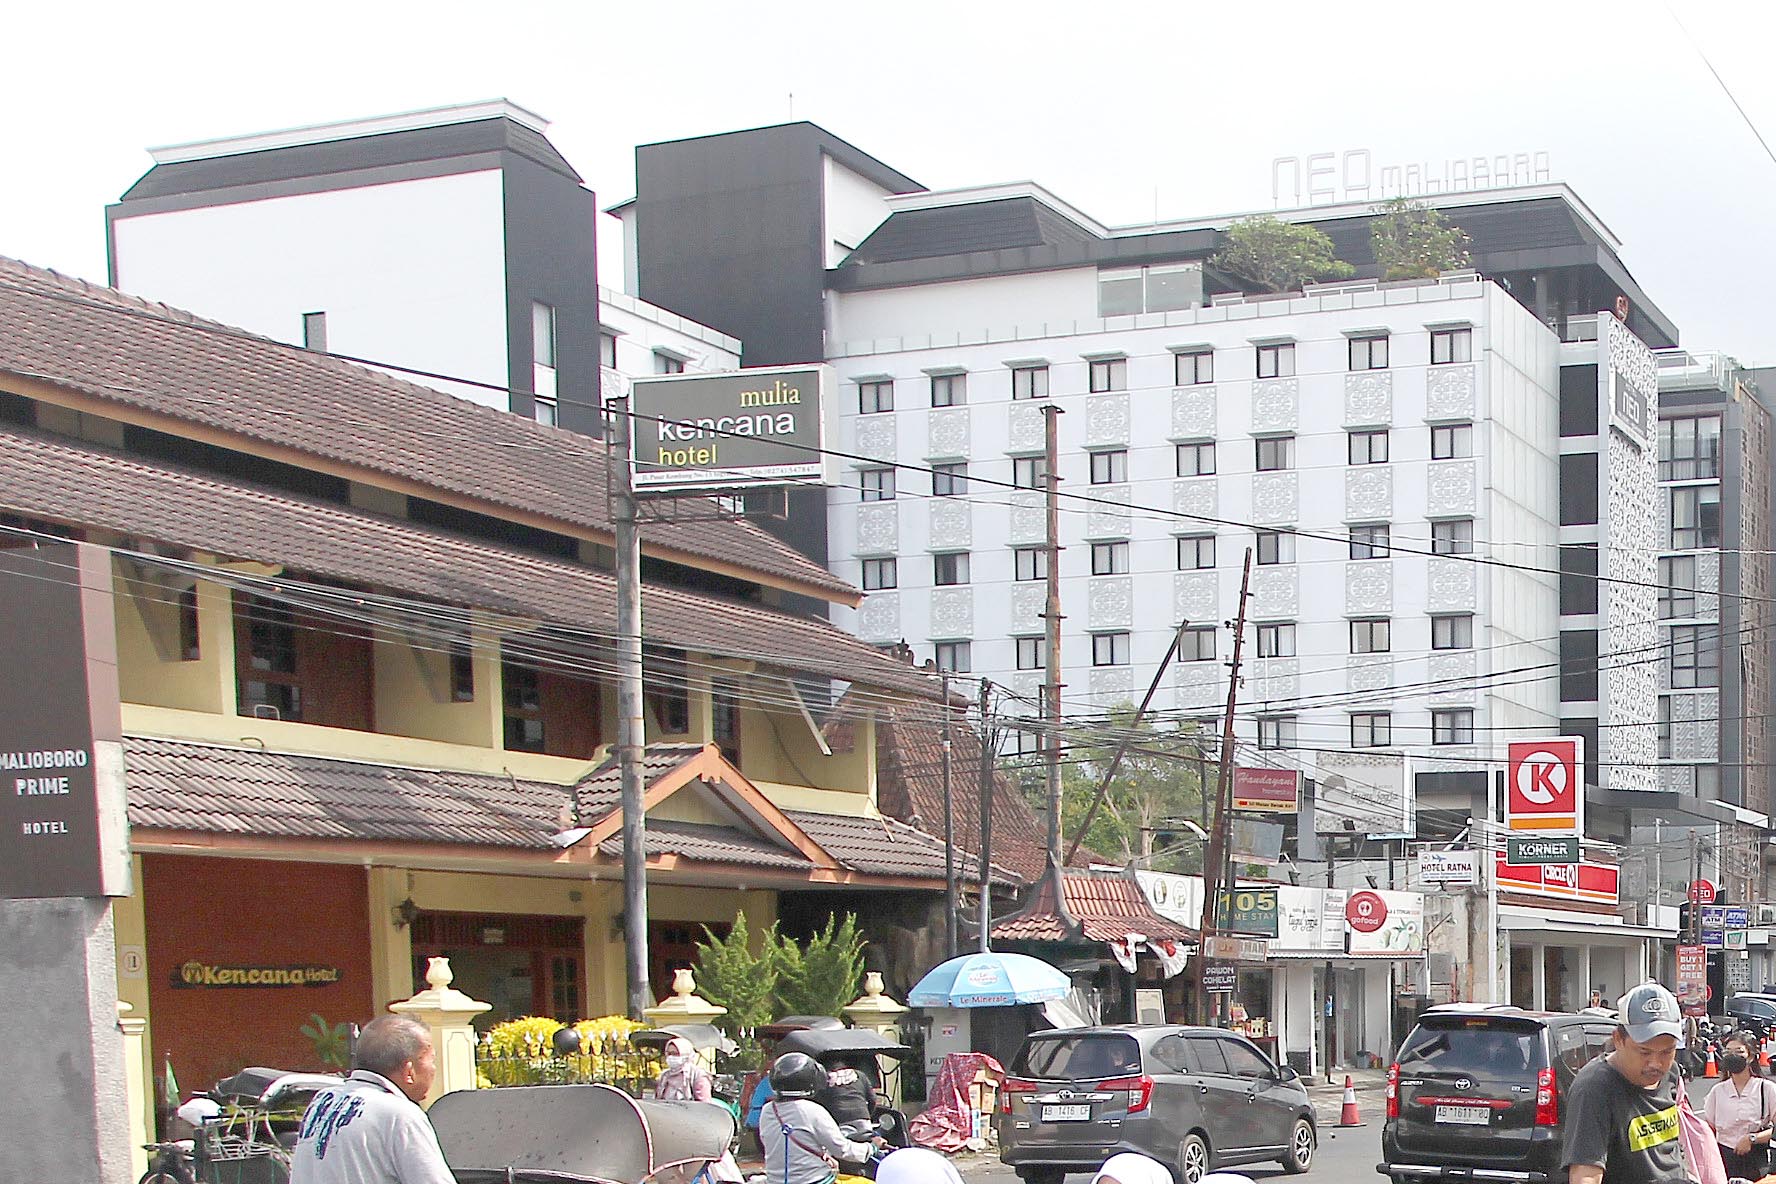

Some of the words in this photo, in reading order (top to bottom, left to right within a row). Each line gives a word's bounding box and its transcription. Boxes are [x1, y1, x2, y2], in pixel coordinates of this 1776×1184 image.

[739, 380, 801, 408] mulia
[656, 412, 796, 442] kencana
[658, 444, 718, 466] hotel
[0, 750, 88, 770] MALIOBORO
[16, 776, 70, 796] PRIME
[23, 821, 68, 835] HOTEL
[1518, 842, 1568, 856] KÖRNER
[1421, 863, 1445, 872] HOTEL
[1447, 863, 1472, 871] RATNA
[1545, 865, 1567, 882] CIRCLE
[1219, 893, 1276, 911] 105
[1220, 912, 1249, 921] HME
[1251, 911, 1274, 921] STAY
[1351, 917, 1379, 925] gofood
[1680, 955, 1697, 963] BUY
[1680, 963, 1697, 971] GET
[204, 965, 306, 985] Kencana
[972, 995, 1008, 1004] Minerale
[1437, 1106, 1447, 1118] AB
